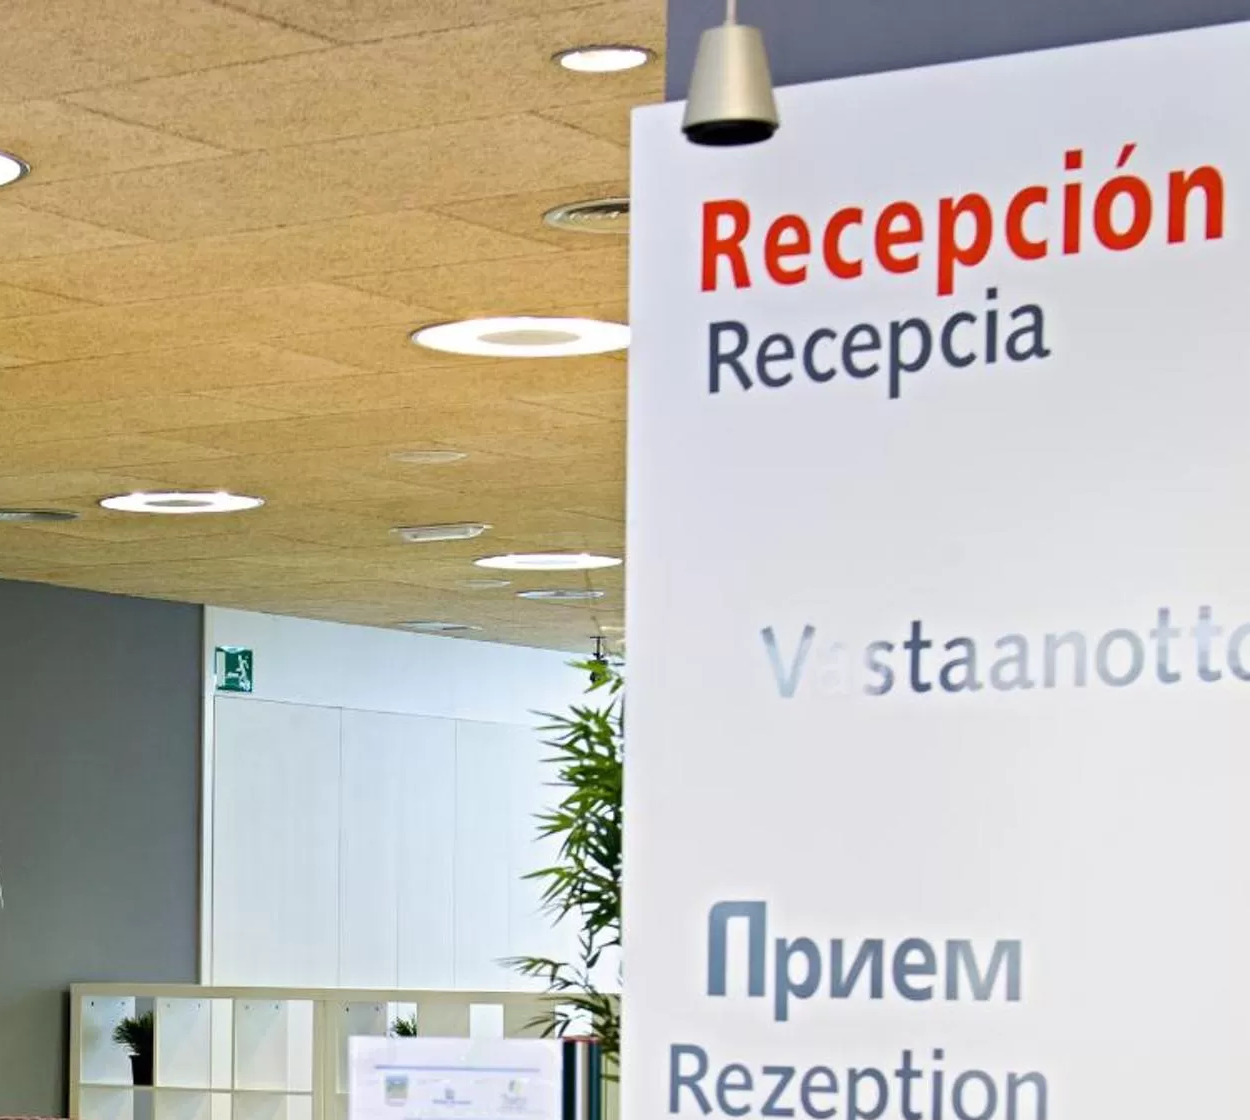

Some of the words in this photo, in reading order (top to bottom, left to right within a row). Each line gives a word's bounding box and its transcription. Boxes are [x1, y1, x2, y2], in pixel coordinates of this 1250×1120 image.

[700, 143, 1224, 296] Recepción
[708, 288, 1051, 399] Recepcia
[760, 605, 1250, 698] Vstaanott
[706, 900, 1023, 1022] Прием
